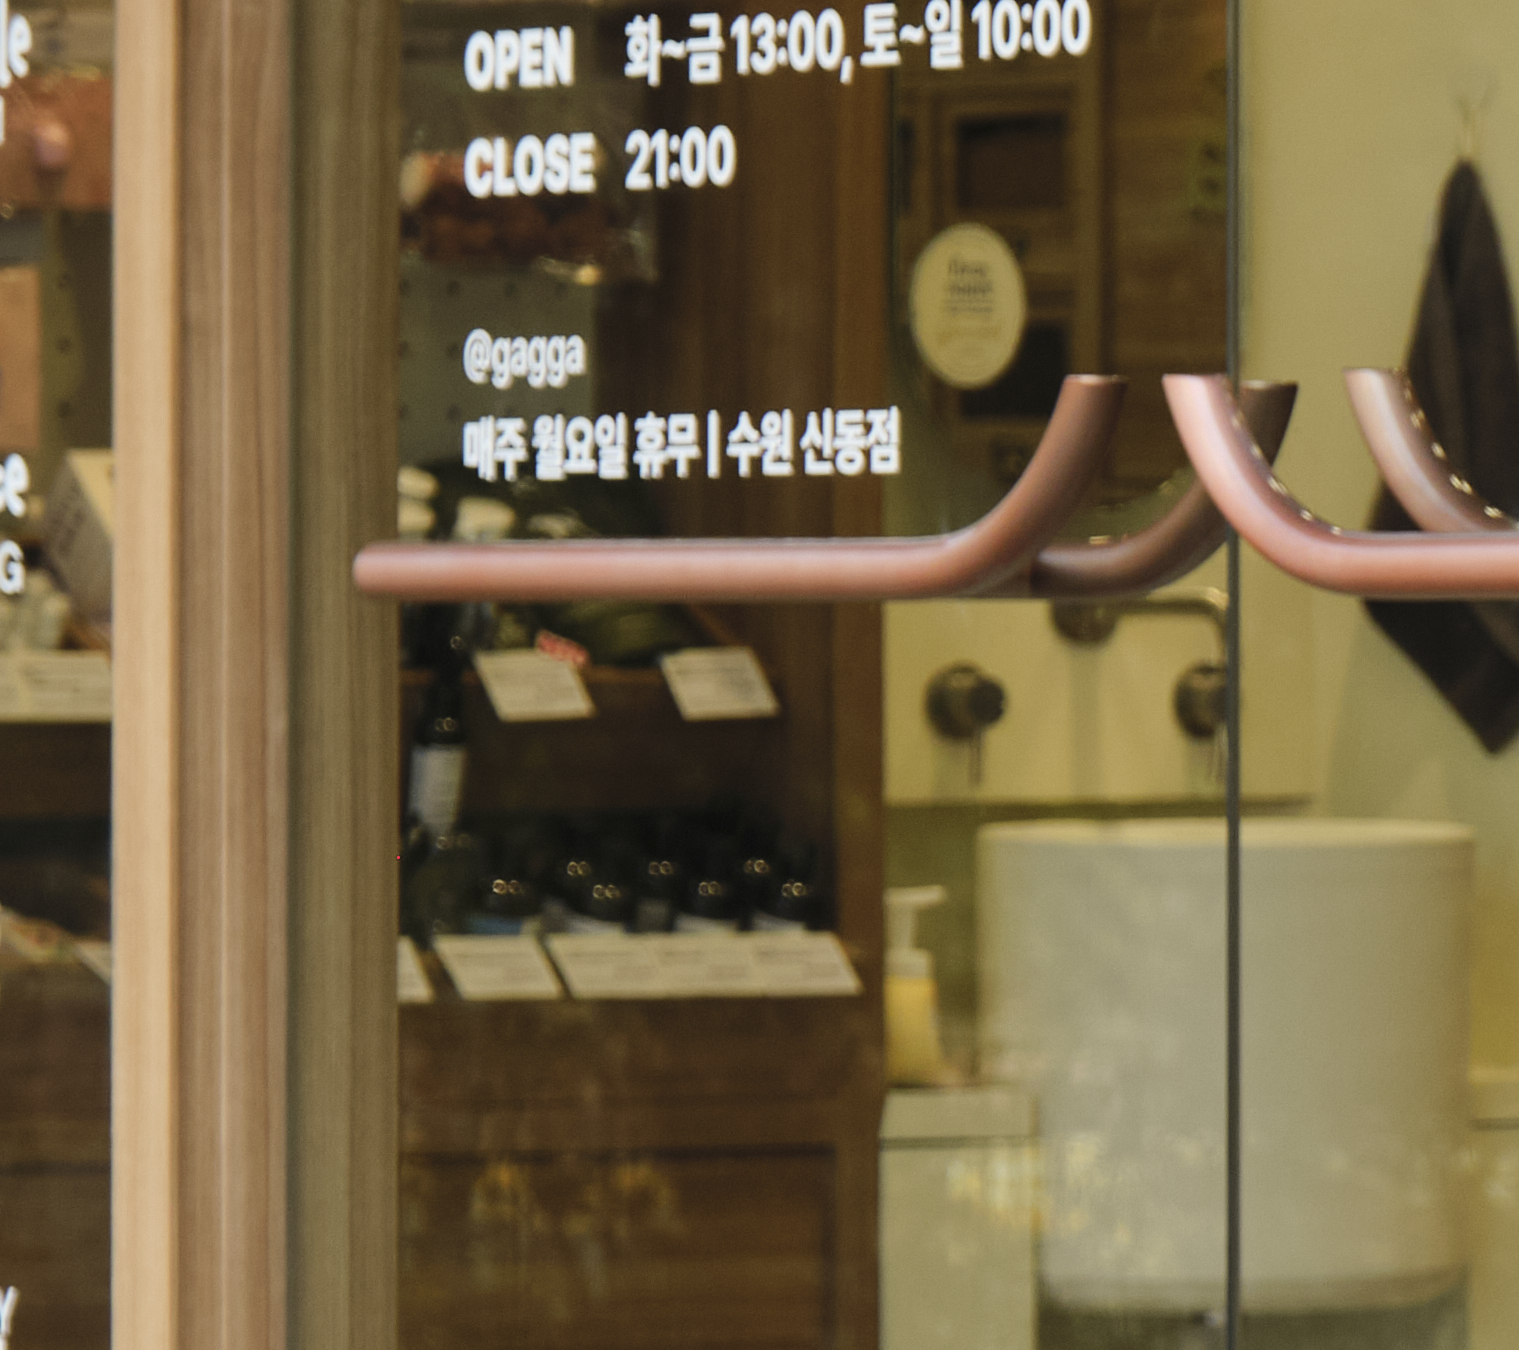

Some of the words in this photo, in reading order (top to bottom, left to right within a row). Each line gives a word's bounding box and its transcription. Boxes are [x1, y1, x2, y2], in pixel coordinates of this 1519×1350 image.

[464, 26, 574, 91] OPEN
[624, 12, 724, 86] 화~금
[859, 0, 963, 70] 토~일
[971, 0, 1092, 60] 10:00
[464, 132, 596, 198] CLOSE
[625, 125, 736, 190] 21:00
[463, 327, 586, 390] @gagga
[463, 414, 528, 482] 매주
[532, 412, 627, 481] 월요일
[633, 410, 700, 479] 휴무
[726, 408, 793, 478] 수원
[799, 405, 900, 476] 신동점
